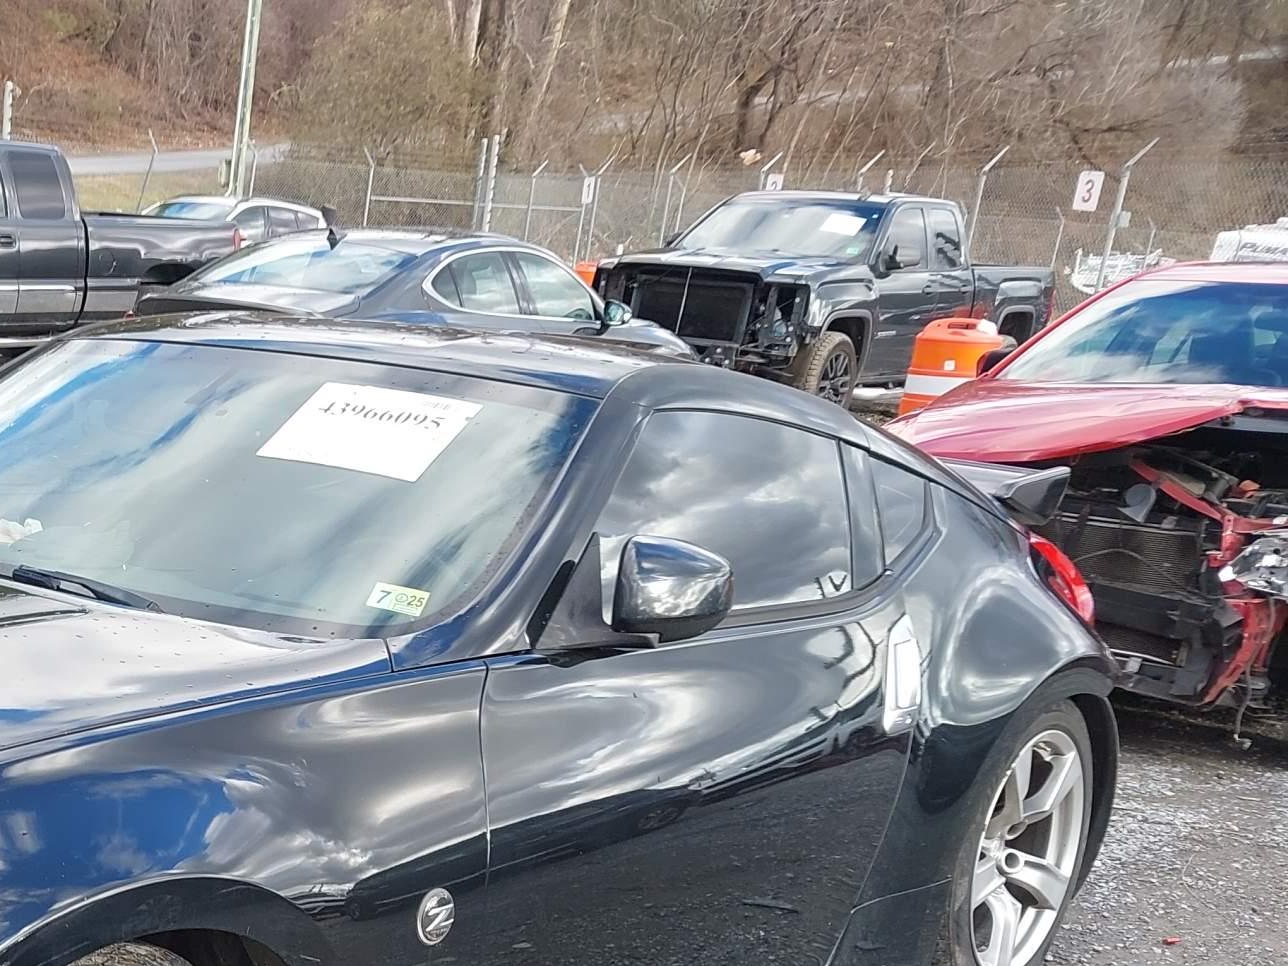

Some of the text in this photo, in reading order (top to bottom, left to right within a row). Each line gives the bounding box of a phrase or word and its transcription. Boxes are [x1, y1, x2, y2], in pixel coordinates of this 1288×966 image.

[1081, 179, 1095, 203] 3
[319, 401, 445, 430] 43966095
[376, 590, 425, 608] 7 25
